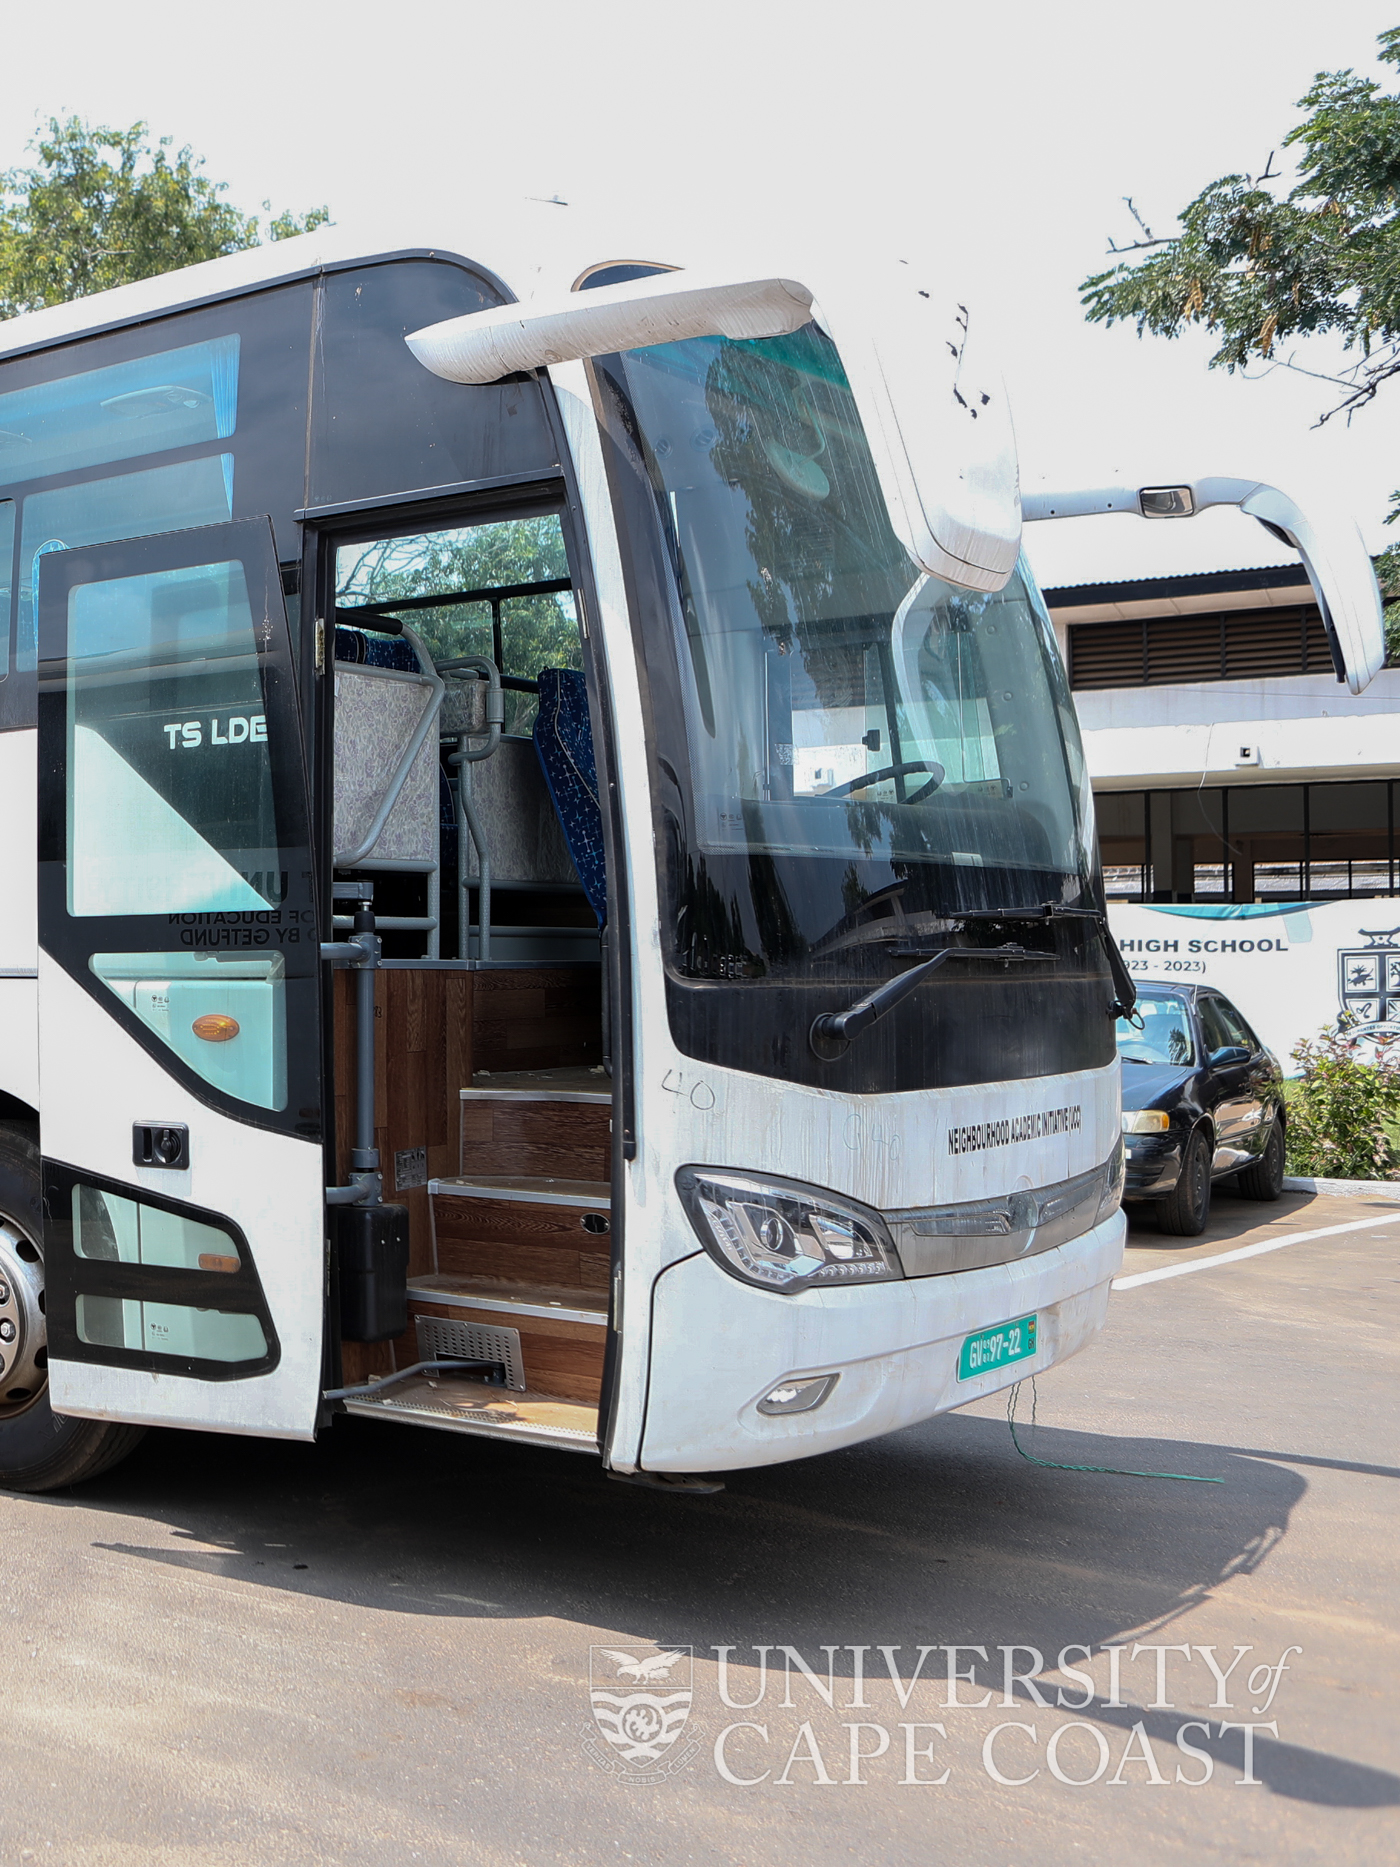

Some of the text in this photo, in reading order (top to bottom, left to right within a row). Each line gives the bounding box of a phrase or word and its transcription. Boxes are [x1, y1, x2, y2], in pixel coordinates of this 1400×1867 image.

[163, 721, 201, 750] TS
[1119, 939, 1289, 953] HIGH SCHOOL
[1124, 960, 1149, 971] 923
[1164, 960, 1207, 974] 2023)
[948, 1119, 1010, 1155] NEIGHBOURHOOD
[1010, 1113, 1041, 1144] ACADEMIC
[1041, 1107, 1069, 1136] INITIATIVE
